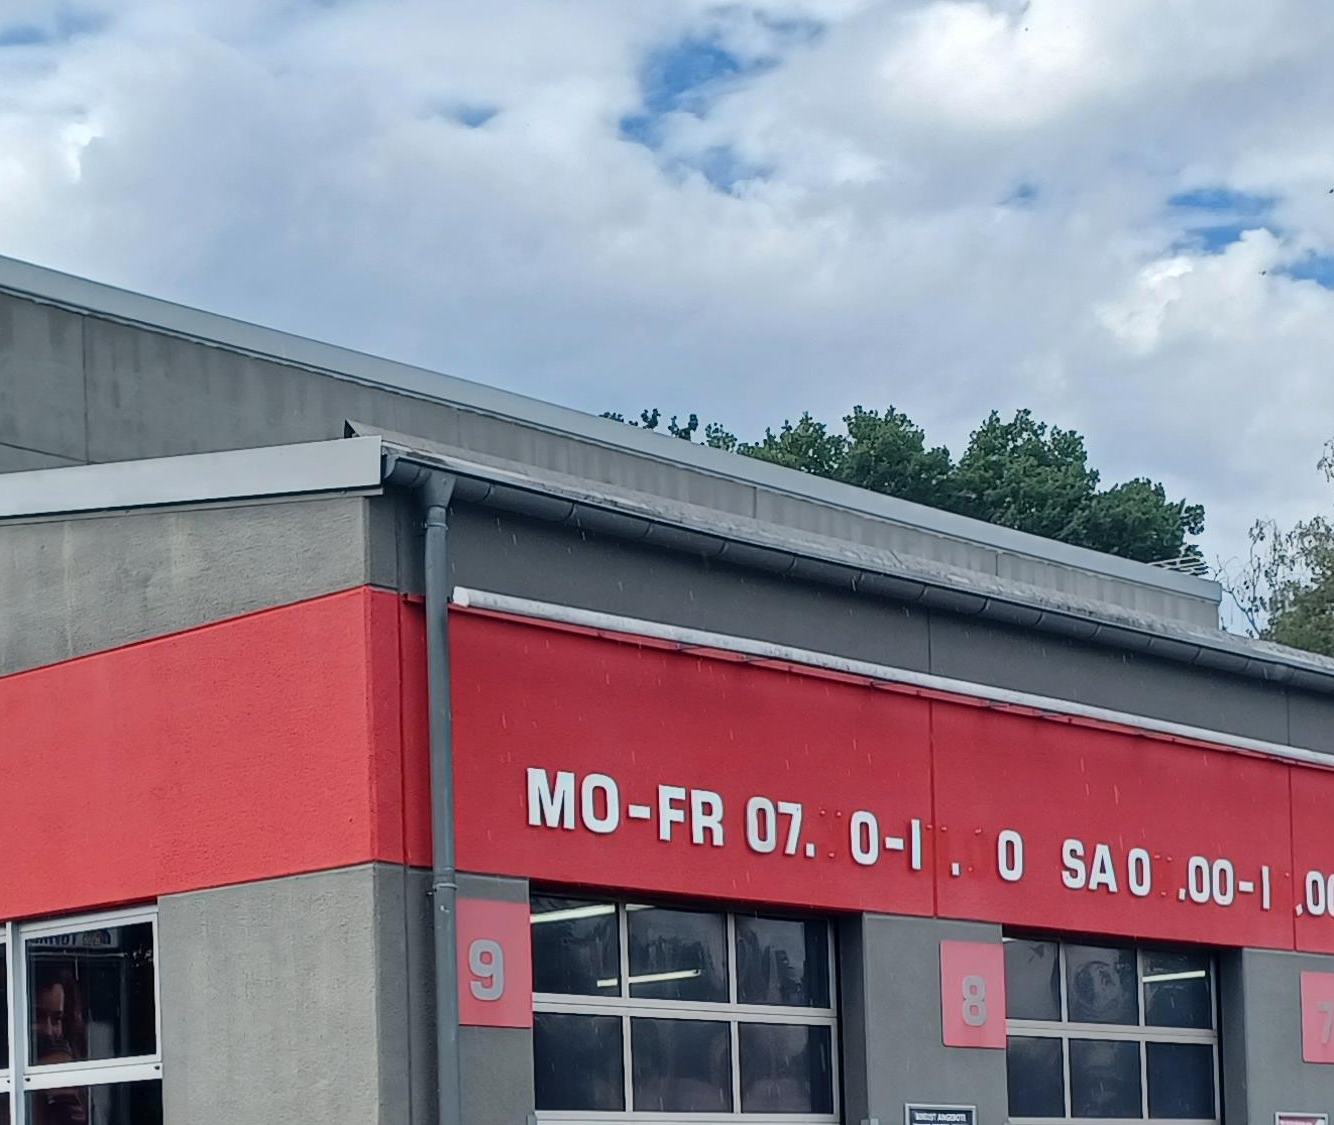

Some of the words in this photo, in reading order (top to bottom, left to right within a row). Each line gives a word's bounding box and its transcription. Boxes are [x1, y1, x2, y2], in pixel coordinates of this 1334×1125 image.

[527, 768, 725, 847] MO-FR
[469, 938, 505, 1001] 9
[962, 975, 988, 1027] 8
[1315, 1000, 1334, 1046] 7
